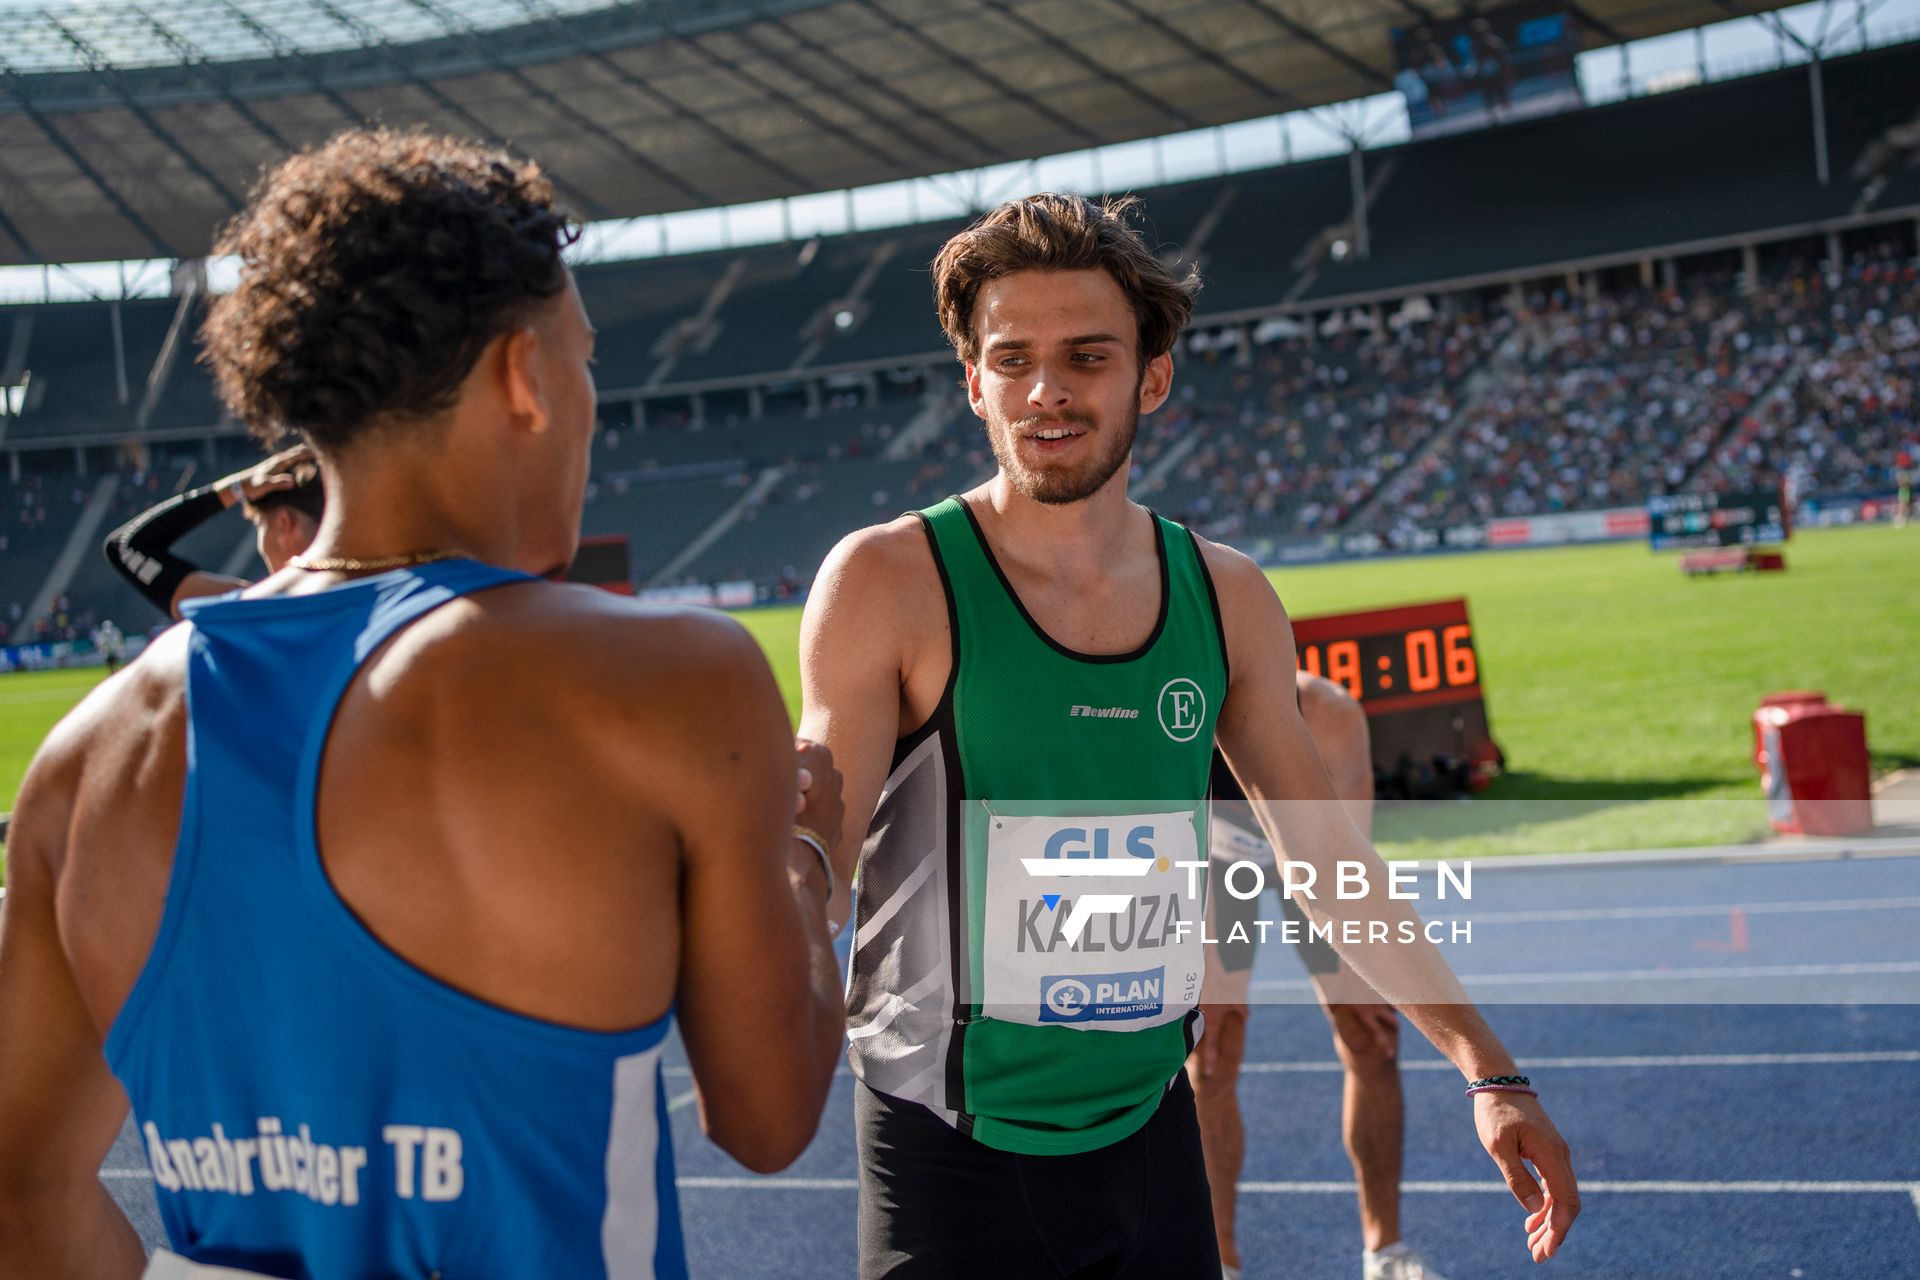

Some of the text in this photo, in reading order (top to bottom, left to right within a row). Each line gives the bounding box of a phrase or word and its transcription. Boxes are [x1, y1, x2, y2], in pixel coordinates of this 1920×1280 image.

[1168, 691, 1196, 729] E
[1095, 977, 1160, 1004] PLAN
[1183, 972, 1197, 1002] 315
[1095, 1002, 1159, 1015] INTERNATIONAL
[381, 1124, 465, 1203] TB
